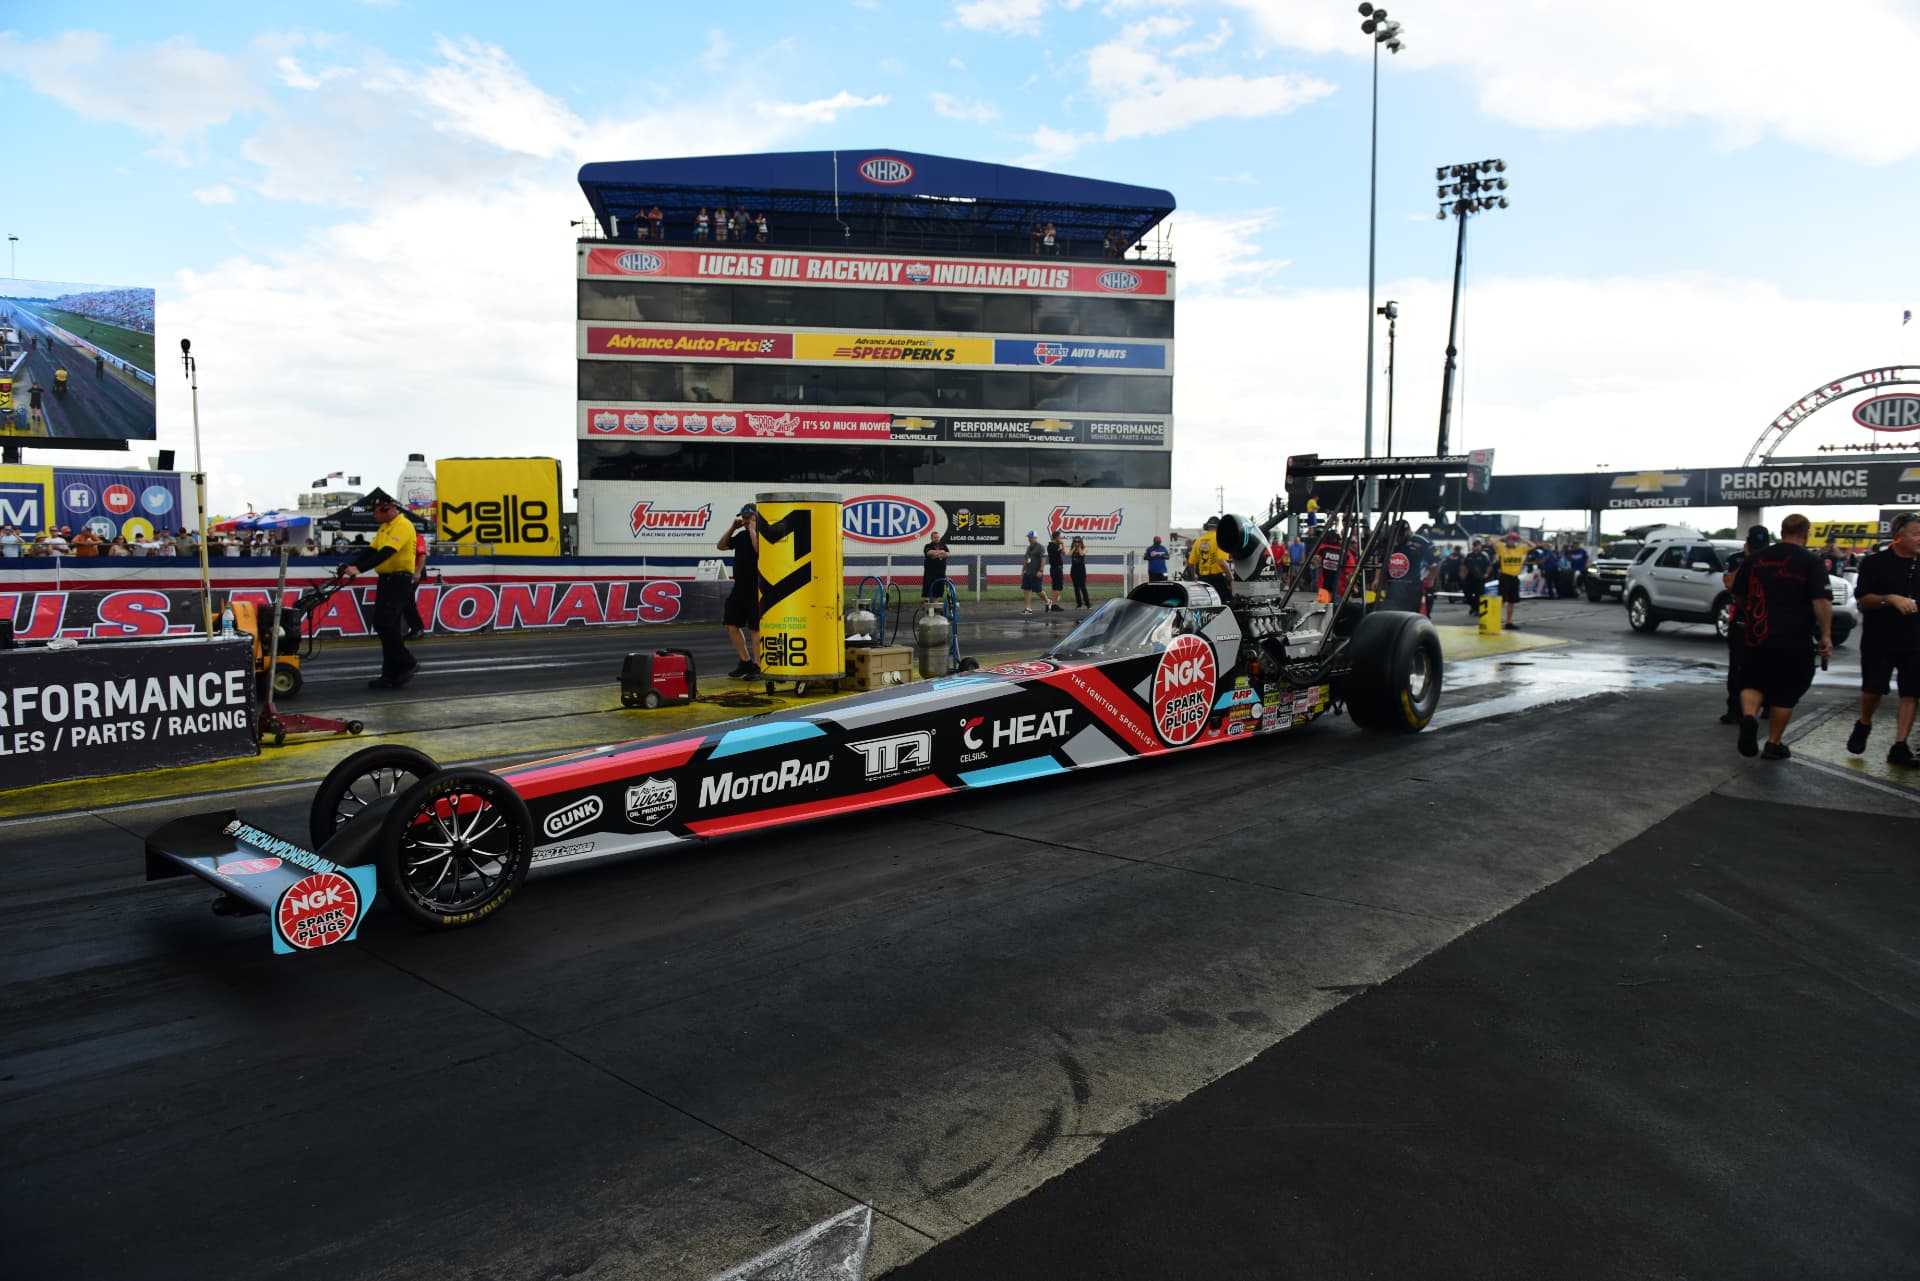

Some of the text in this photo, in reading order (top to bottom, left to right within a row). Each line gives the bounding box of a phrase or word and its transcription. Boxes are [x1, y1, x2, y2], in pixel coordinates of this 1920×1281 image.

[864, 160, 908, 181] NHRA
[622, 255, 661, 271] NHRA
[698, 255, 763, 277] LUCAS
[770, 258, 800, 278] OIL
[806, 259, 903, 283] RACEWAY
[933, 264, 1069, 289] INDIANAPOLIS
[1100, 272, 1140, 289] NHRA
[607, 334, 758, 353] Advance Auto Parts
[855, 338, 886, 346] Advance
[1071, 349, 1096, 359] AUTO
[1097, 349, 1127, 360] PARTS
[802, 421, 819, 431] IT'S
[820, 421, 831, 431] SO
[833, 421, 857, 432] MUCH
[859, 421, 891, 433] MOWER
[890, 433, 938, 441] CHEVROLET
[953, 421, 1030, 433] PERFORMANCE
[1090, 423, 1164, 435] PERFORMANCE
[1720, 469, 1869, 491] PERFORMANCE
[1609, 497, 1692, 508] CHEVROLET
[1721, 489, 1771, 501] VEHICLES
[1780, 488, 1812, 500] PARTS
[1825, 487, 1868, 499] RACING
[843, 502, 921, 538] NHRA
[1164, 655, 1207, 693] NGK
[1165, 689, 1206, 716] SPARK
[1230, 689, 1253, 701] ARP
[1071, 673, 1158, 748] THE IGNITION SPECIALIST
[1164, 706, 1205, 732] PLUGS
[71, 720, 146, 747] PARTS
[168, 709, 248, 737] RACING
[992, 708, 1074, 748] HEAT
[631, 789, 673, 809] LUCAS
[549, 801, 598, 832] GUNK
[629, 803, 674, 819] OIL PRODUCTS
[290, 884, 343, 916] NGK
[297, 908, 345, 930] SPARK
[299, 919, 347, 942] PLUGS
